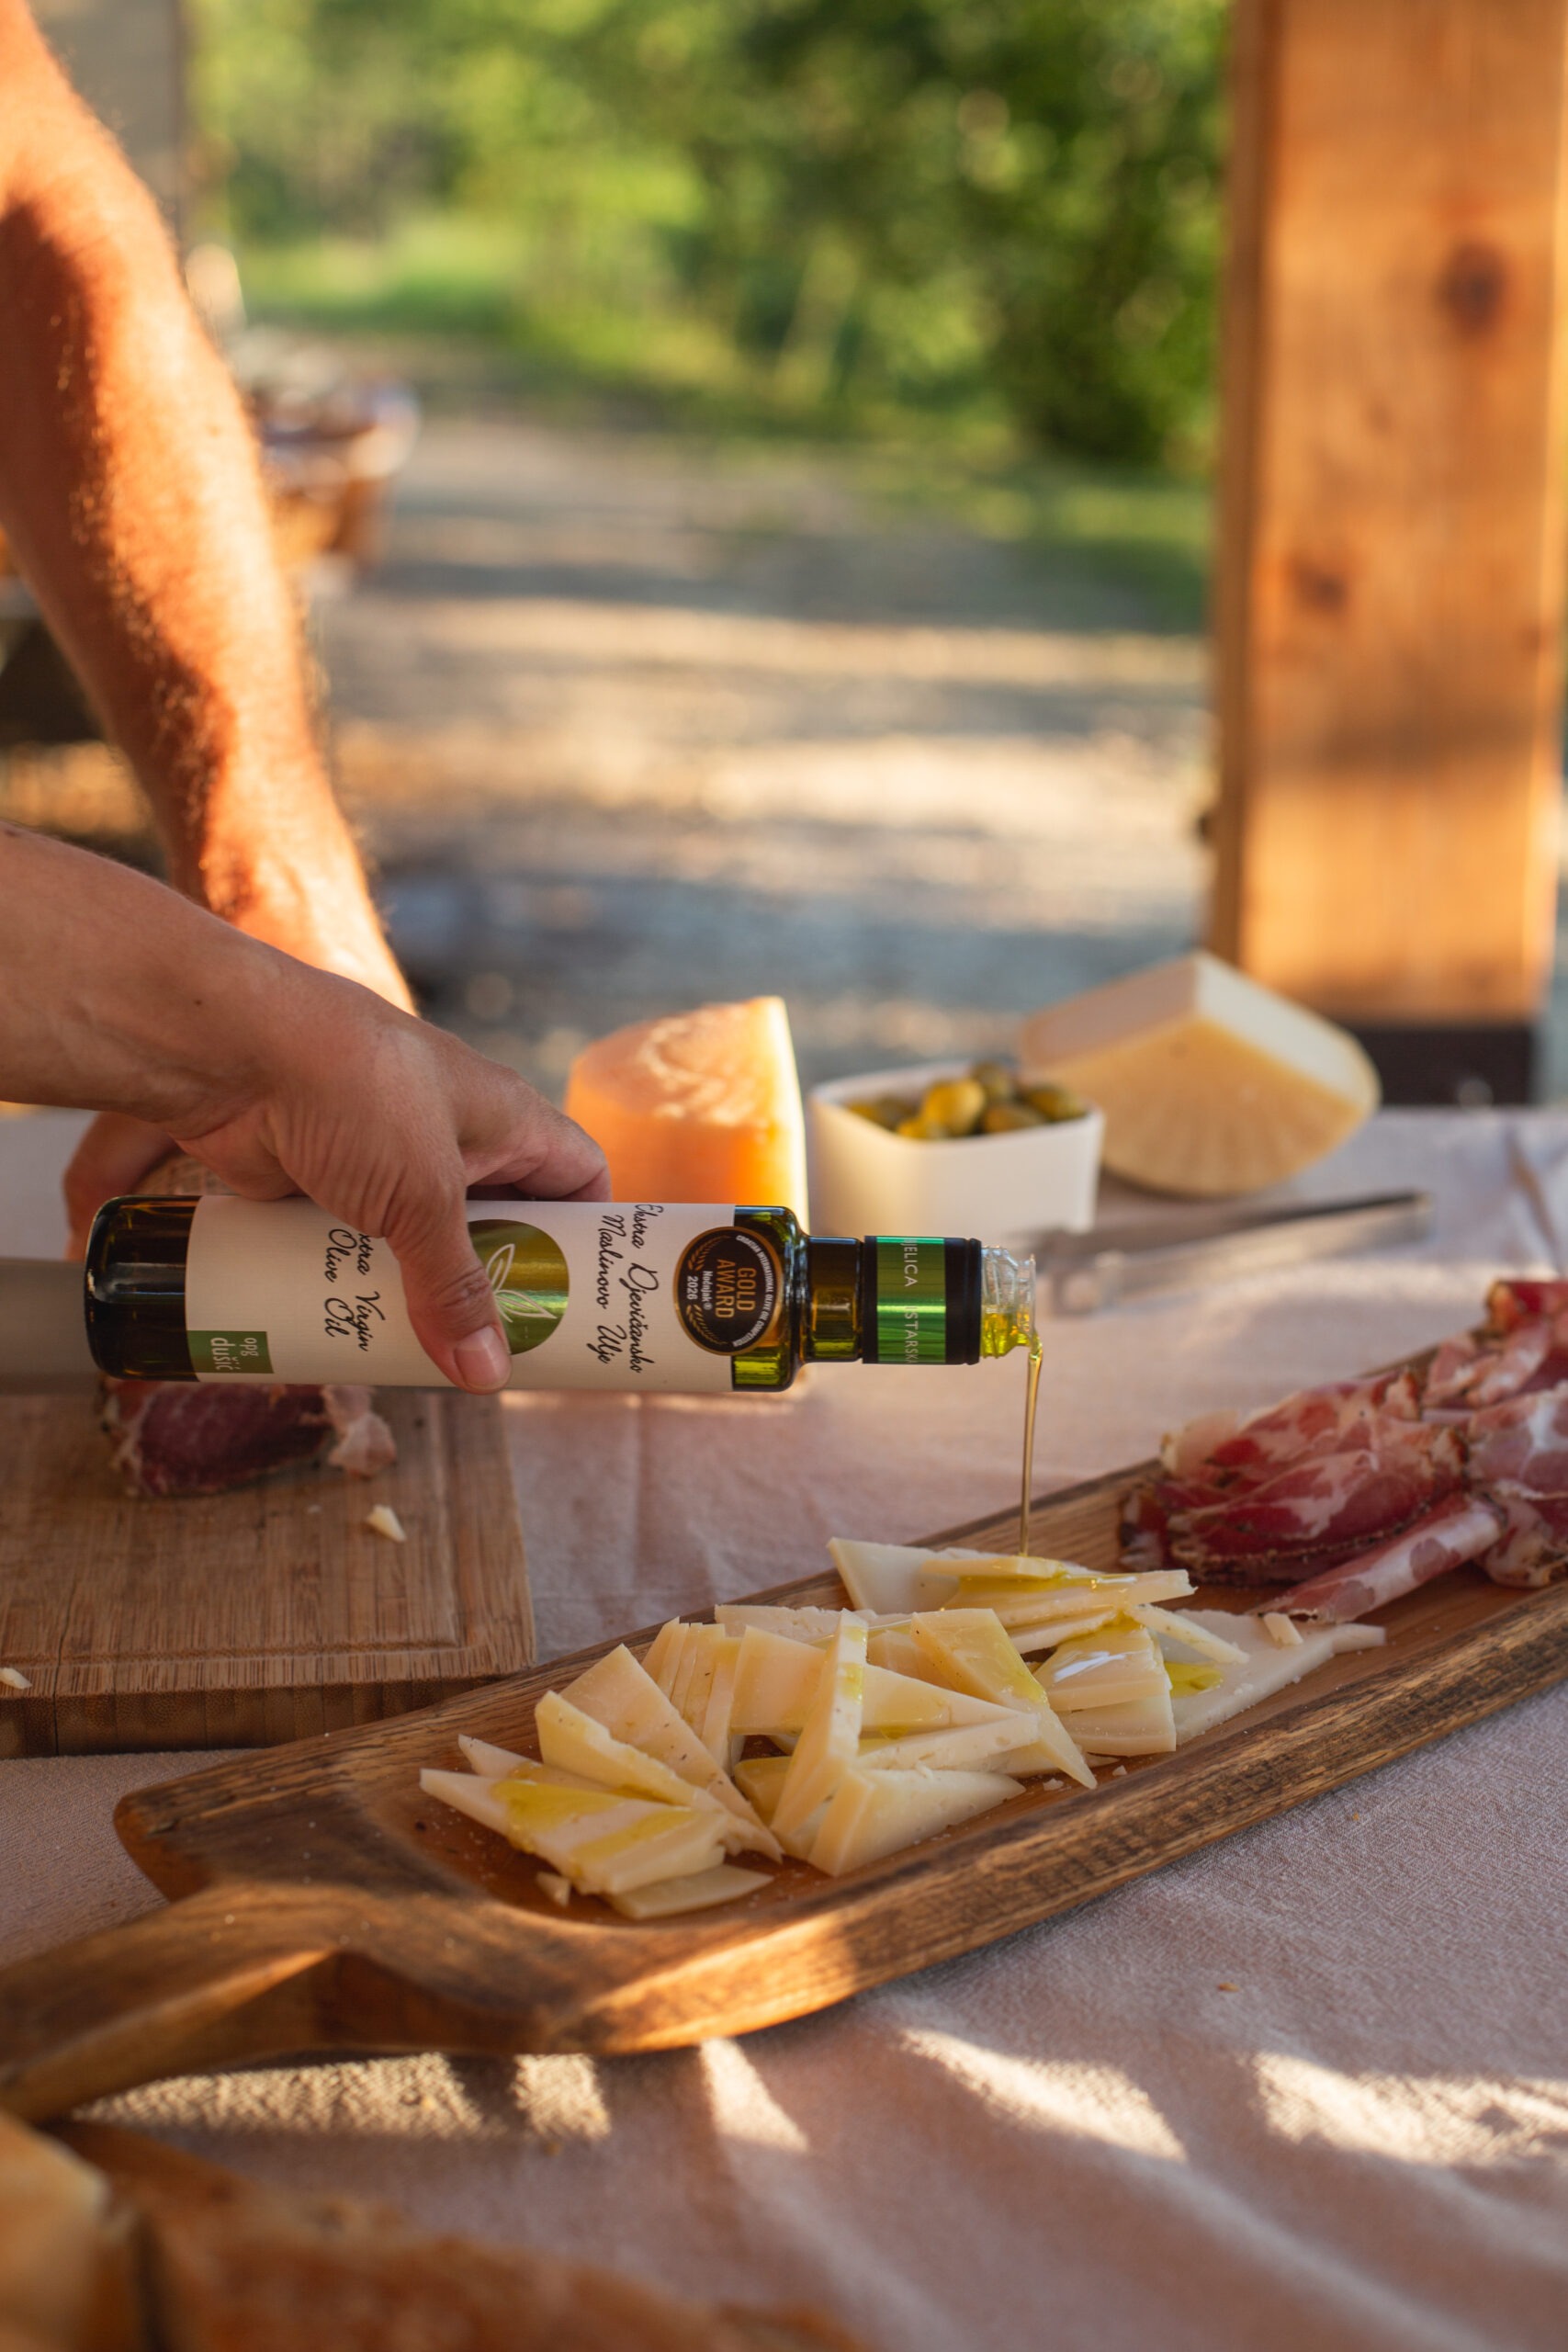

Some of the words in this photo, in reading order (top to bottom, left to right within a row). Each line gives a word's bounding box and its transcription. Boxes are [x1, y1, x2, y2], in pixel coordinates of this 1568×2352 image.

[631, 1204, 664, 1249] Ekstra
[323, 1228, 357, 1283] Olive
[357, 1233, 374, 1275] xtra
[597, 1214, 626, 1309] Maslinovo
[757, 1251, 773, 1293] INTERNATIONAL
[686, 1275, 698, 1300] 2026
[715, 1259, 737, 1318] AWARD
[736, 1267, 757, 1311] GOLD
[763, 1294, 773, 1311] OLIVE
[323, 1297, 355, 1338] Oil
[346, 1291, 386, 1351] Virgin
[619, 1262, 660, 1374] Djevičansko
[759, 1311, 769, 1321] OIL
[210, 1337, 241, 1371] dušić
[240, 1337, 258, 1357] opg
[586, 1324, 627, 1364] Ulje
